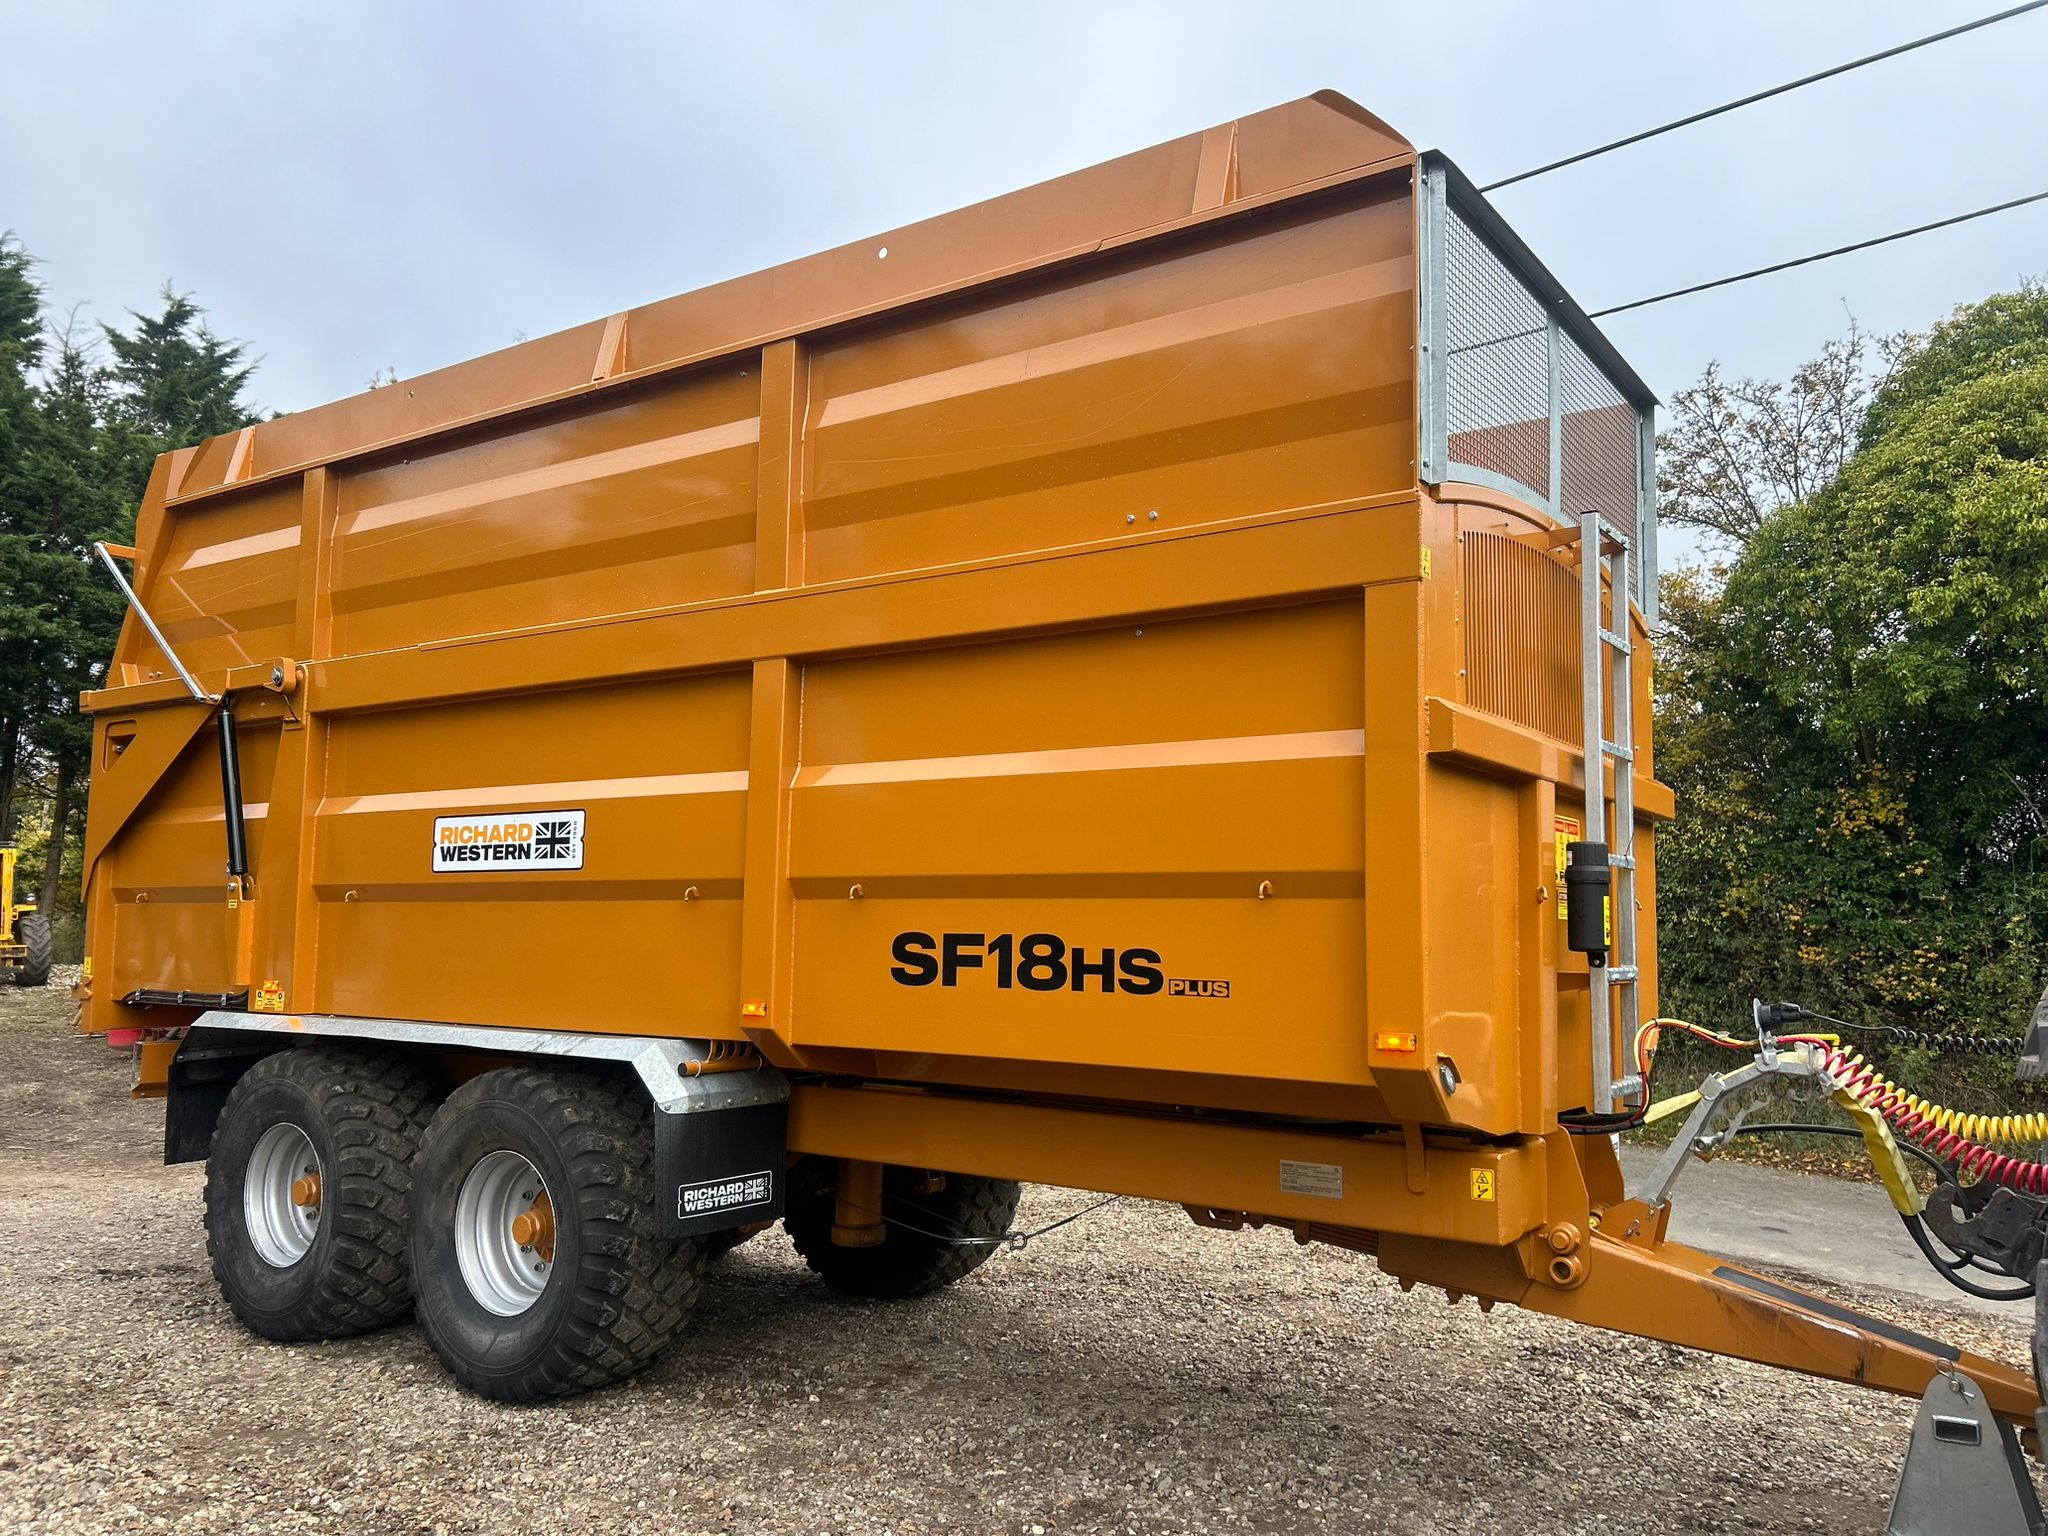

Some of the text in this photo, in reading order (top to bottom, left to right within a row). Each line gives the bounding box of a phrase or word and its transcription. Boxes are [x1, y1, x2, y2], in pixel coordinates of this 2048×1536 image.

[440, 823, 533, 844] RICHARD
[440, 844, 532, 862] WESTERN
[1168, 978, 1231, 998] PLUS
[684, 1182, 743, 1202] RICHARD
[684, 1193, 743, 1212] WESTERN
